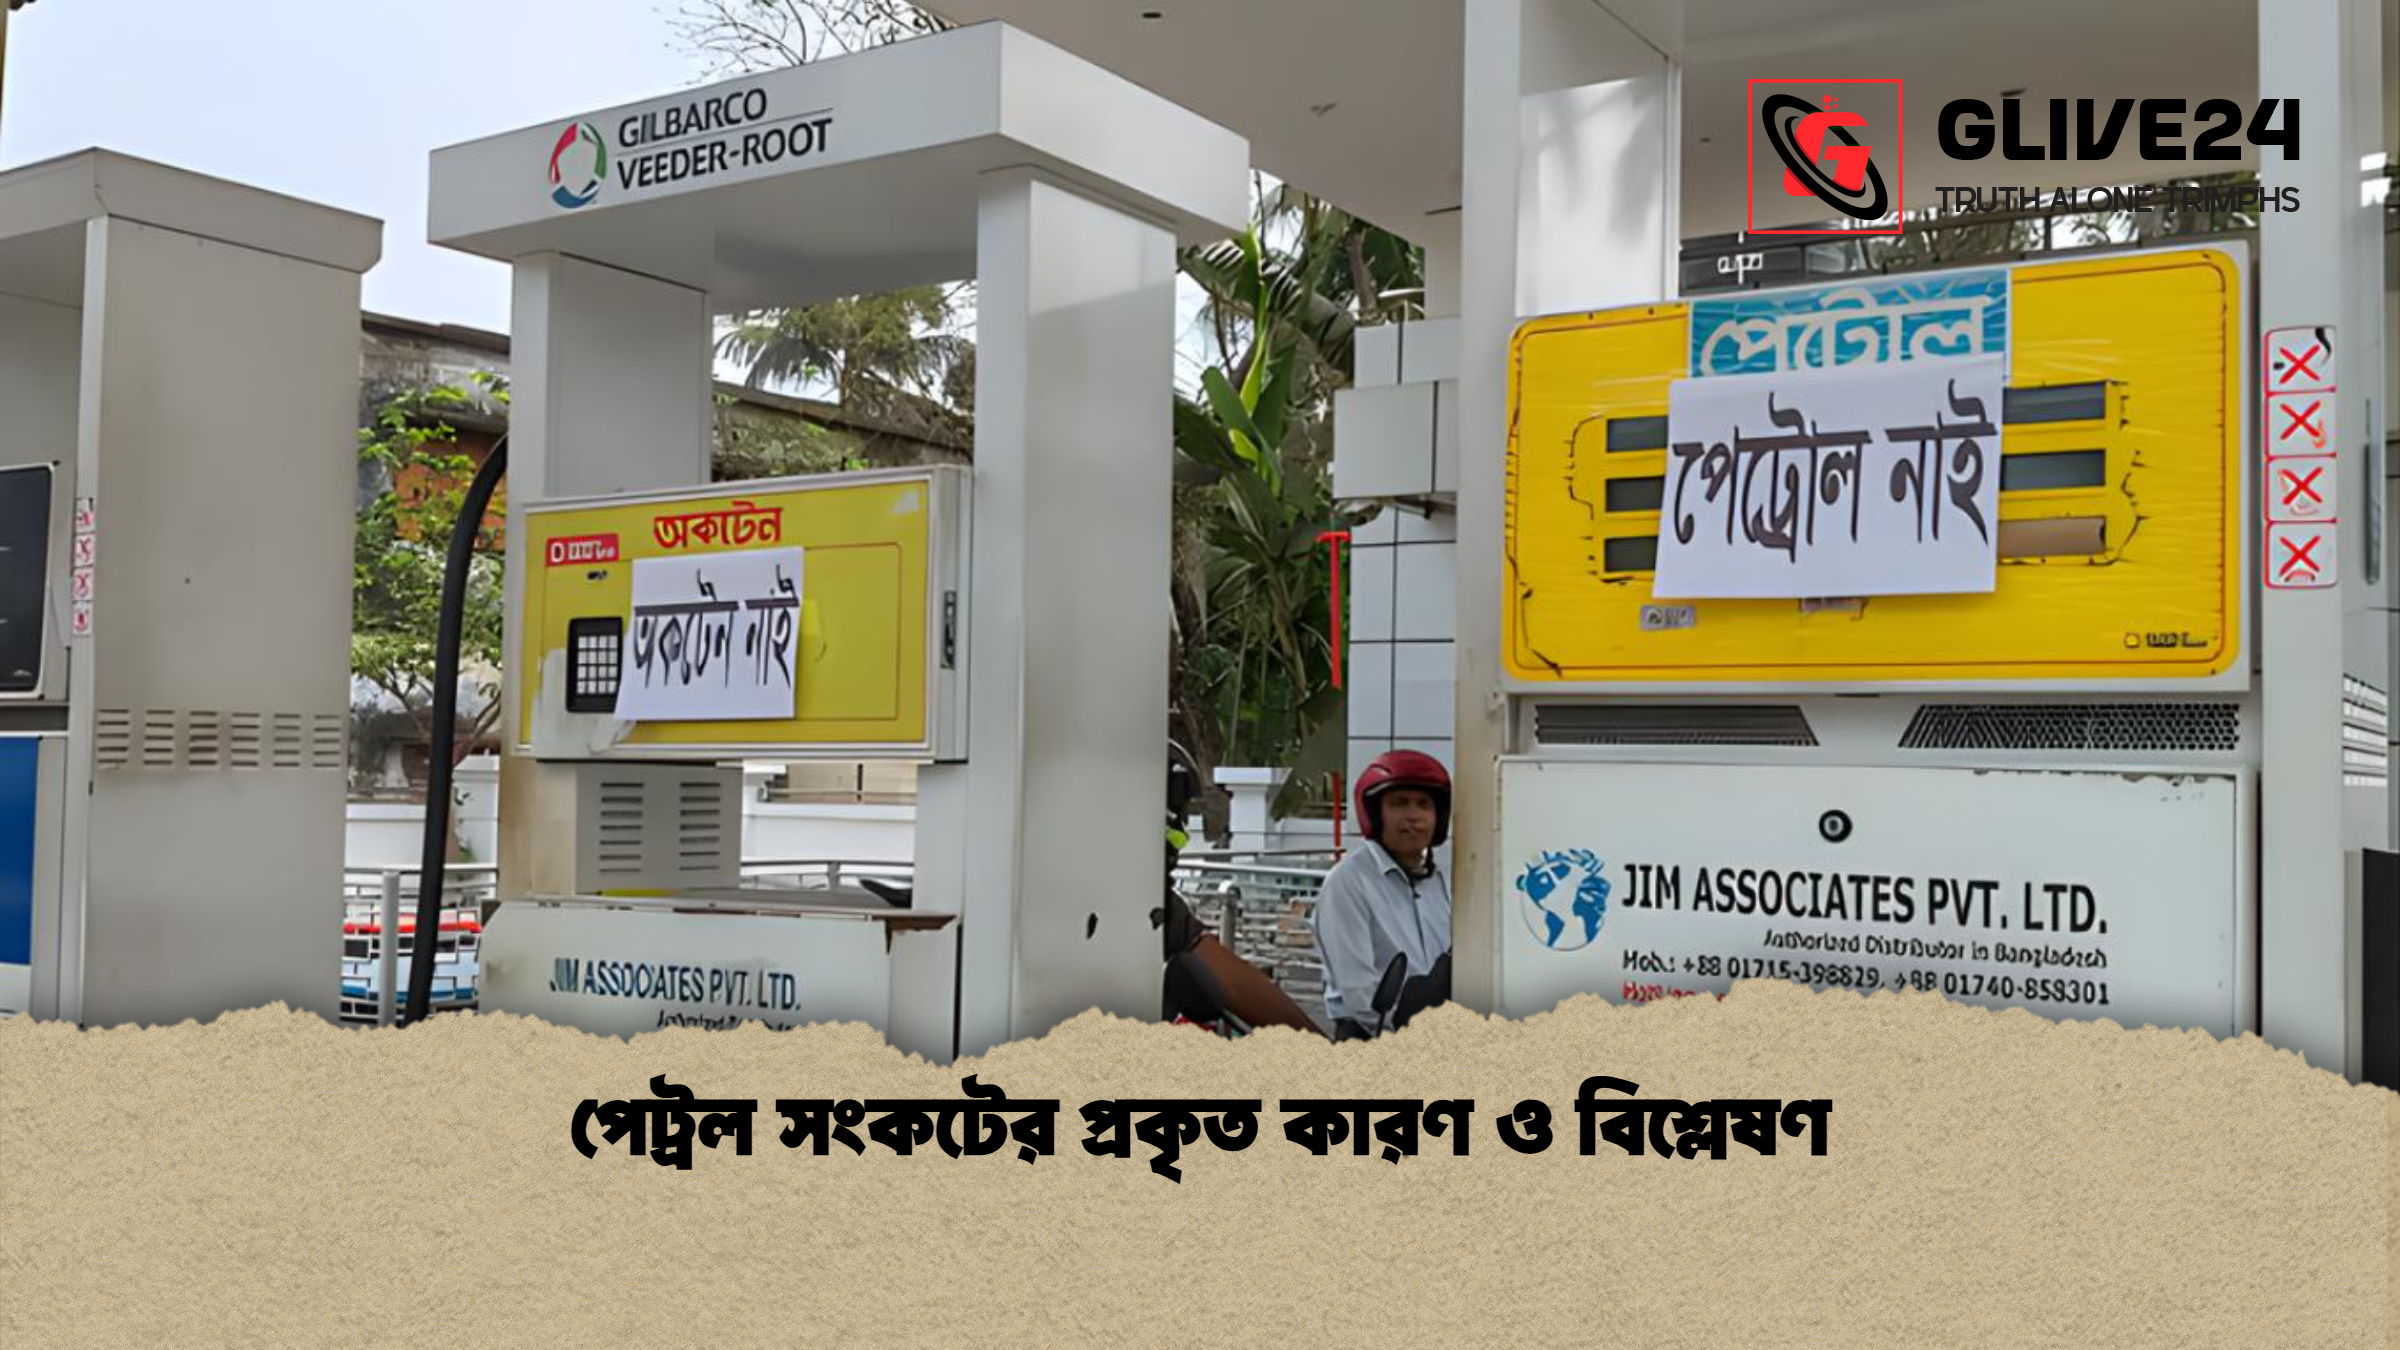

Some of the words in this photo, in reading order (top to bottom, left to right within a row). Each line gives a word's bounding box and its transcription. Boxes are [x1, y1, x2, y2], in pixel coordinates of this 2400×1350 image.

[618, 88, 767, 147] GILBARCO
[617, 118, 832, 189] VEEDER-ROOT
[1885, 378, 1997, 546] নাই
[654, 501, 783, 548] অকটেন
[1622, 864, 1681, 911] JIM
[1692, 867, 1915, 924] ASSOCIATES
[1928, 878, 2007, 929] PVT.
[2024, 882, 2107, 935] LTD.
